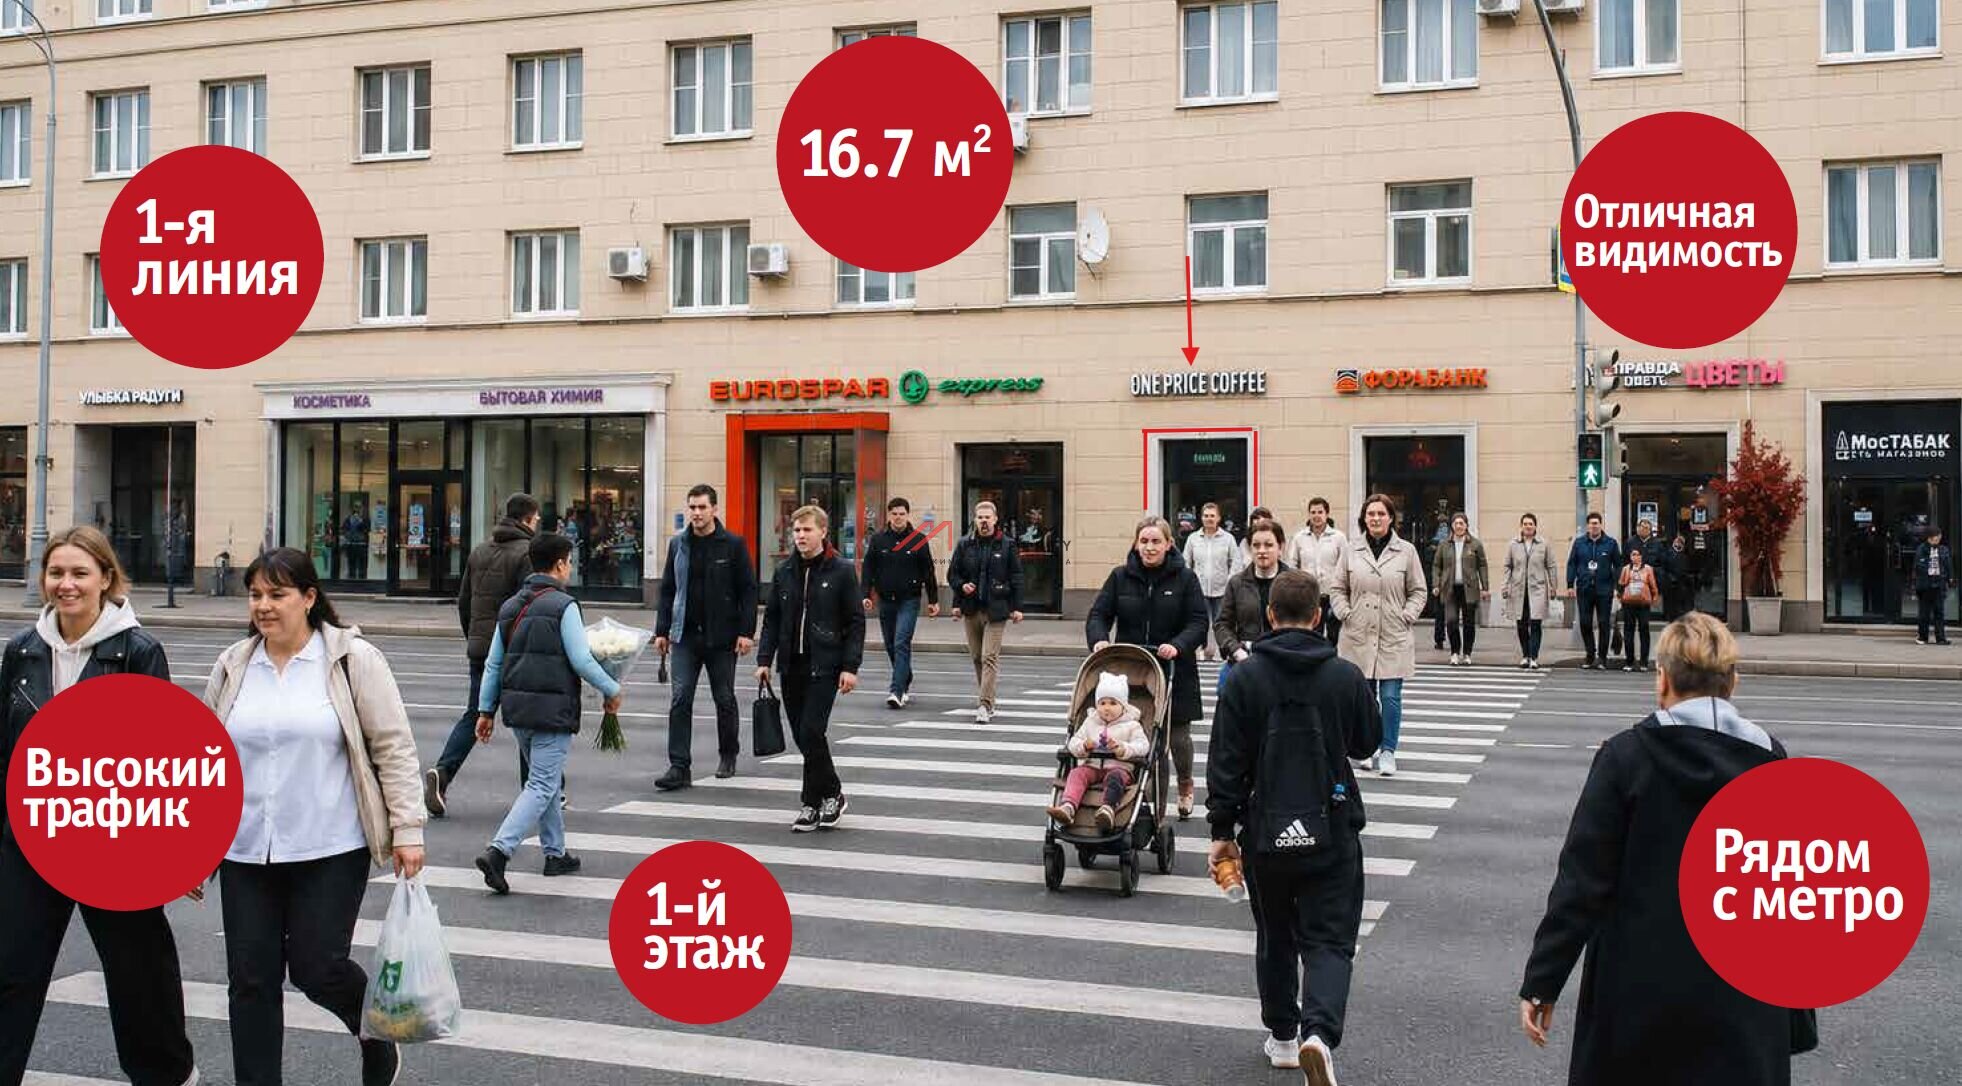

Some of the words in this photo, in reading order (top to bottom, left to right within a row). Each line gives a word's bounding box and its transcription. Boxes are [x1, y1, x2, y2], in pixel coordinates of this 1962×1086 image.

[1130, 373, 1160, 396] ONE
[1163, 372, 1208, 394] PRICE
[1211, 370, 1267, 394] COFFEE
[1362, 368, 1488, 389] ФОРАБАНК
[1685, 359, 1784, 388] ЦВЕТЫ
[79, 389, 130, 405] УЛЫБКА
[131, 388, 184, 404] РАДУГИ
[479, 389, 546, 406] БЫТОВАЯ
[551, 387, 604, 405] ХИМИЯ
[708, 377, 889, 401] EUROSPAR
[936, 376, 1043, 398] express
[293, 394, 371, 410] КОСМЕТИКА
